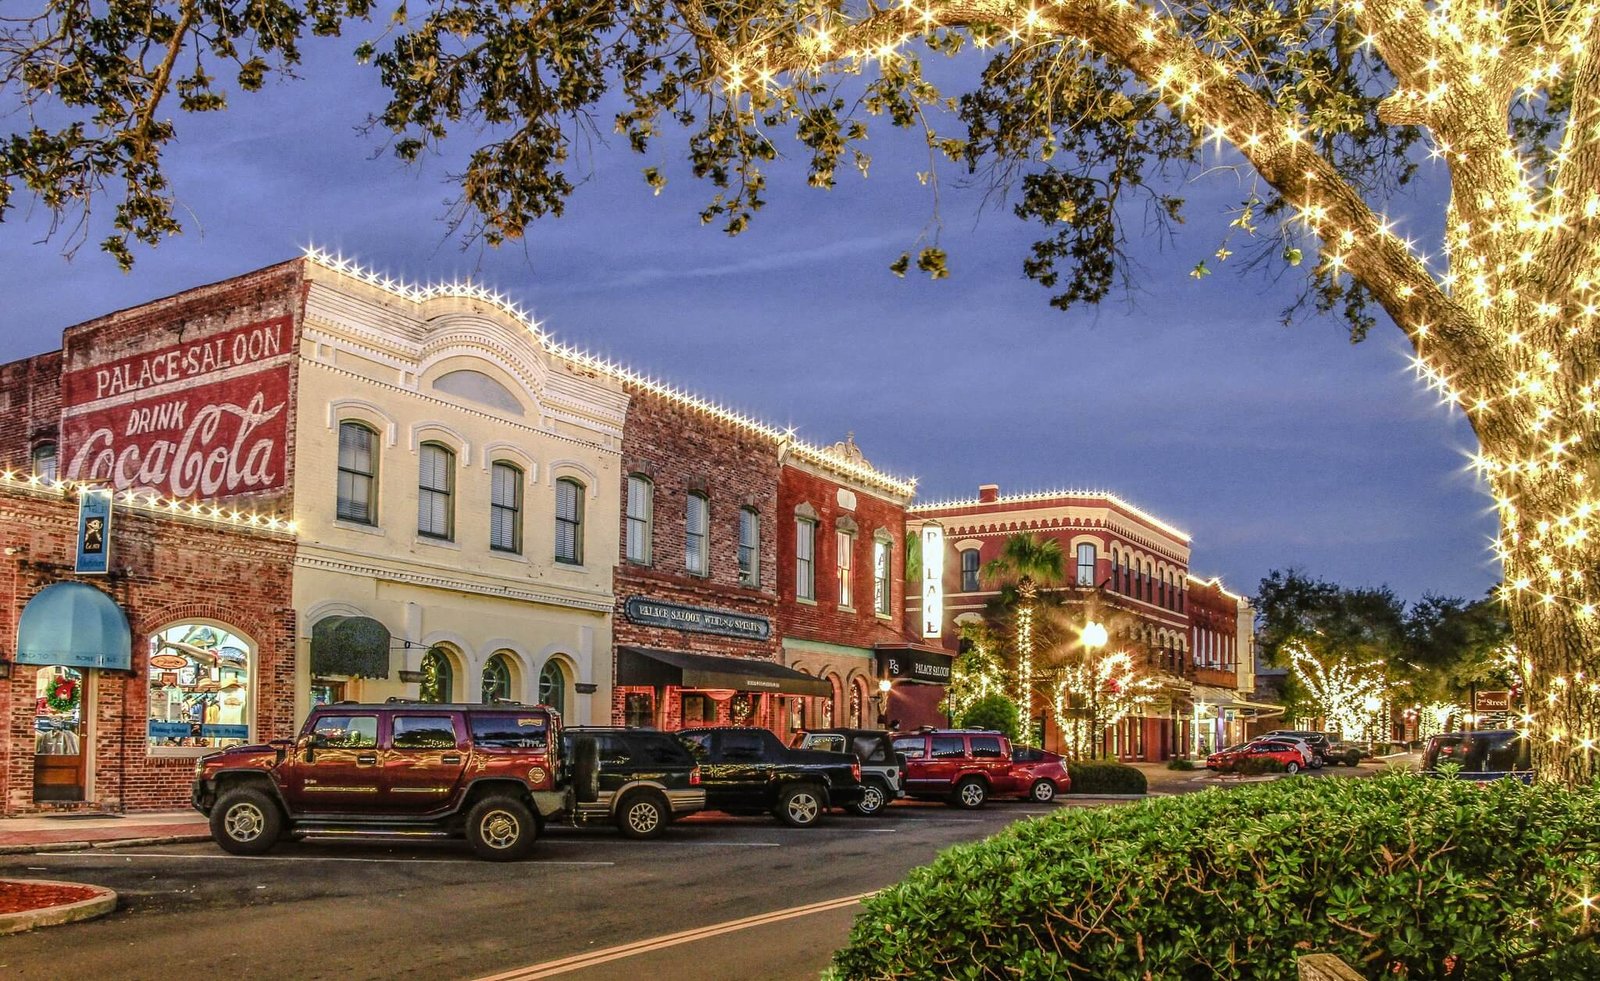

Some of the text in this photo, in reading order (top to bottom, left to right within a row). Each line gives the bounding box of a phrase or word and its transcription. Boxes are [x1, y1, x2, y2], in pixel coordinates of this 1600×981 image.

[96, 324, 282, 399] PALACE SALOON
[126, 401, 188, 436] DRINK
[640, 604, 669, 618] PALACE
[671, 610, 701, 622] SALOON
[915, 663, 950, 677] PALACE SALOON
[1486, 698, 1507, 706] Street
